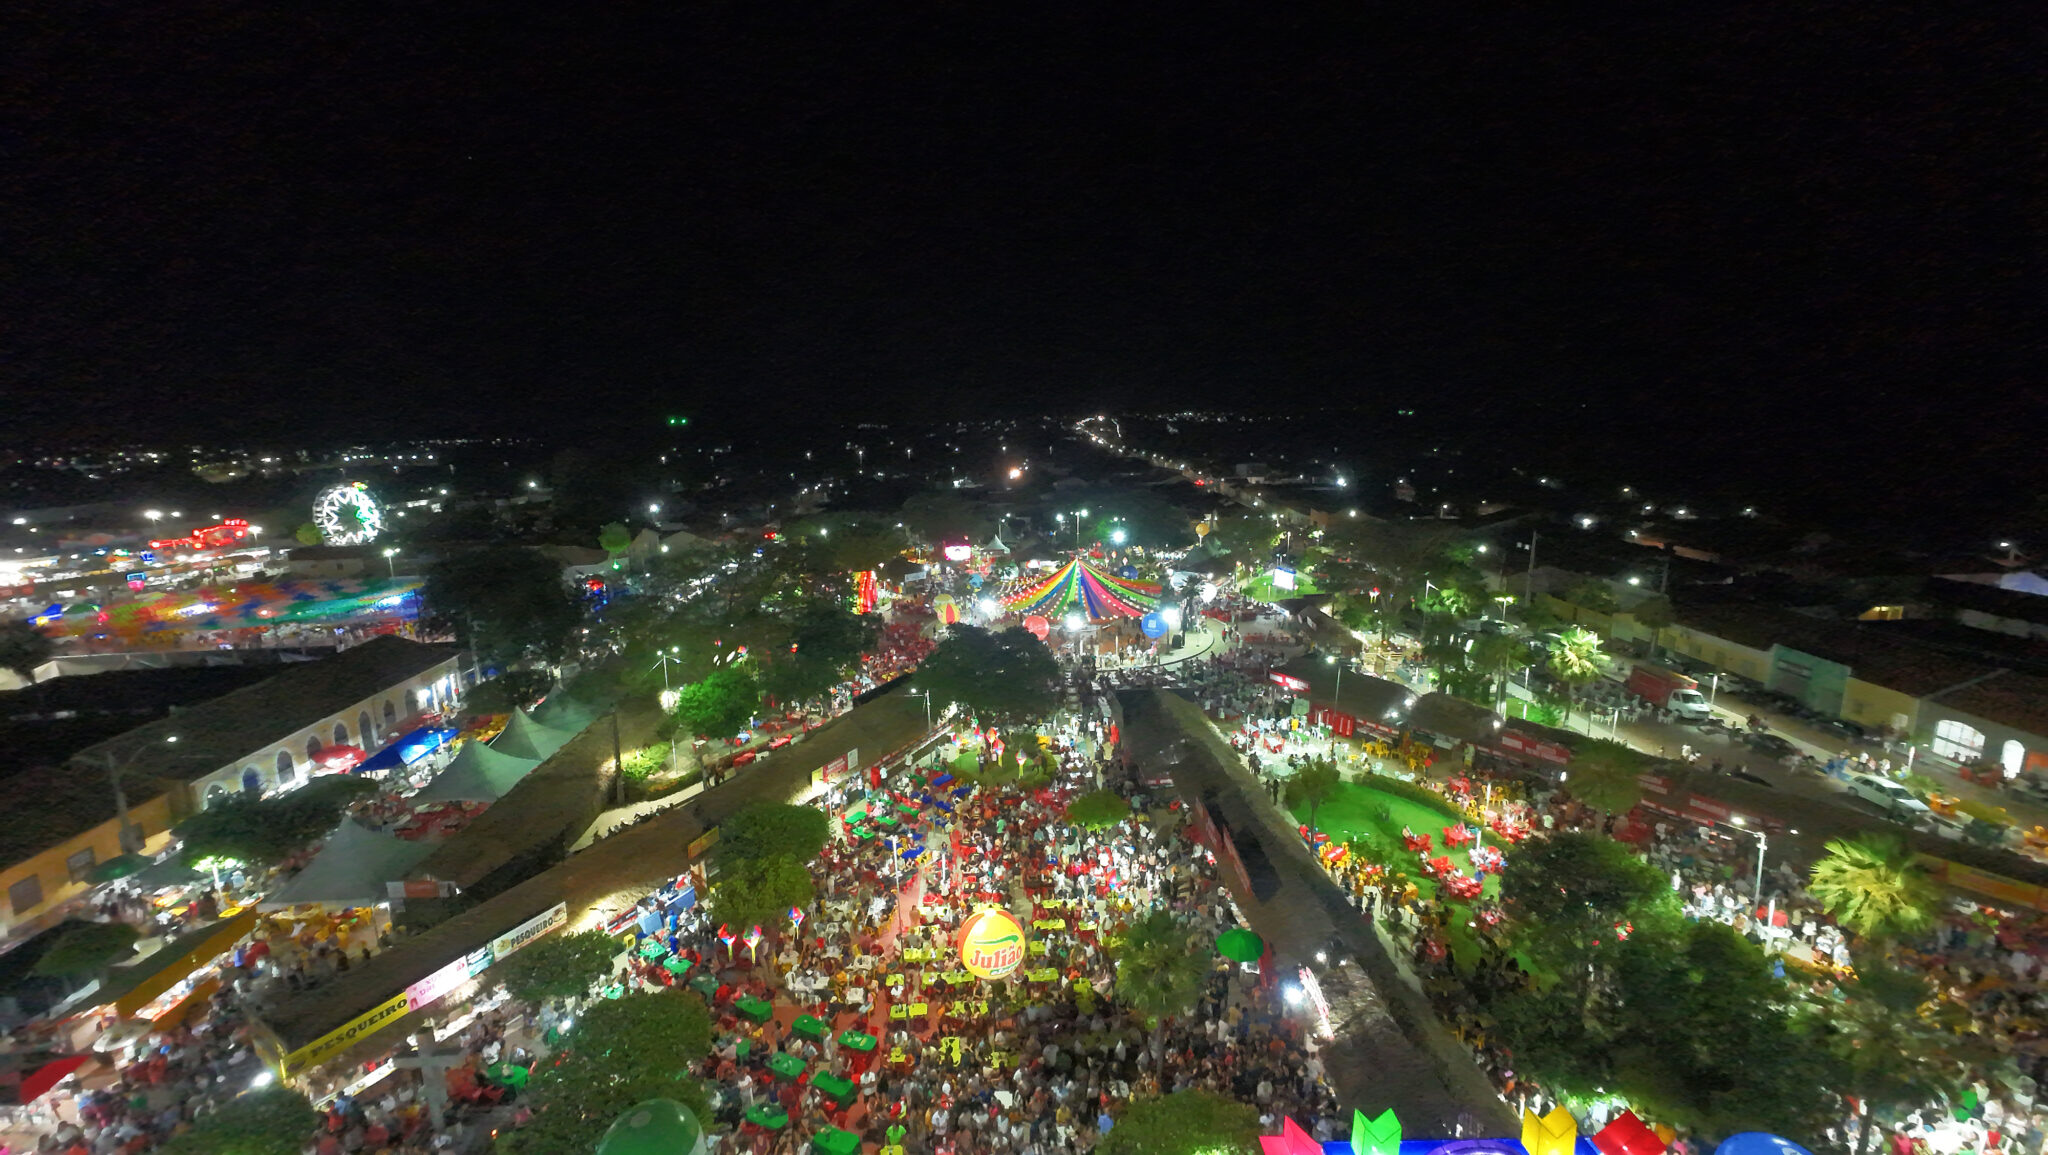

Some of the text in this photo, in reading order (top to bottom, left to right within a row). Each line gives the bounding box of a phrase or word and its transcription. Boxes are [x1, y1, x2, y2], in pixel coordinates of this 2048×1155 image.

[509, 916, 554, 948] PESQUEIRO
[969, 943, 1023, 969] Julião
[309, 998, 408, 1058] PESQUEIRO
